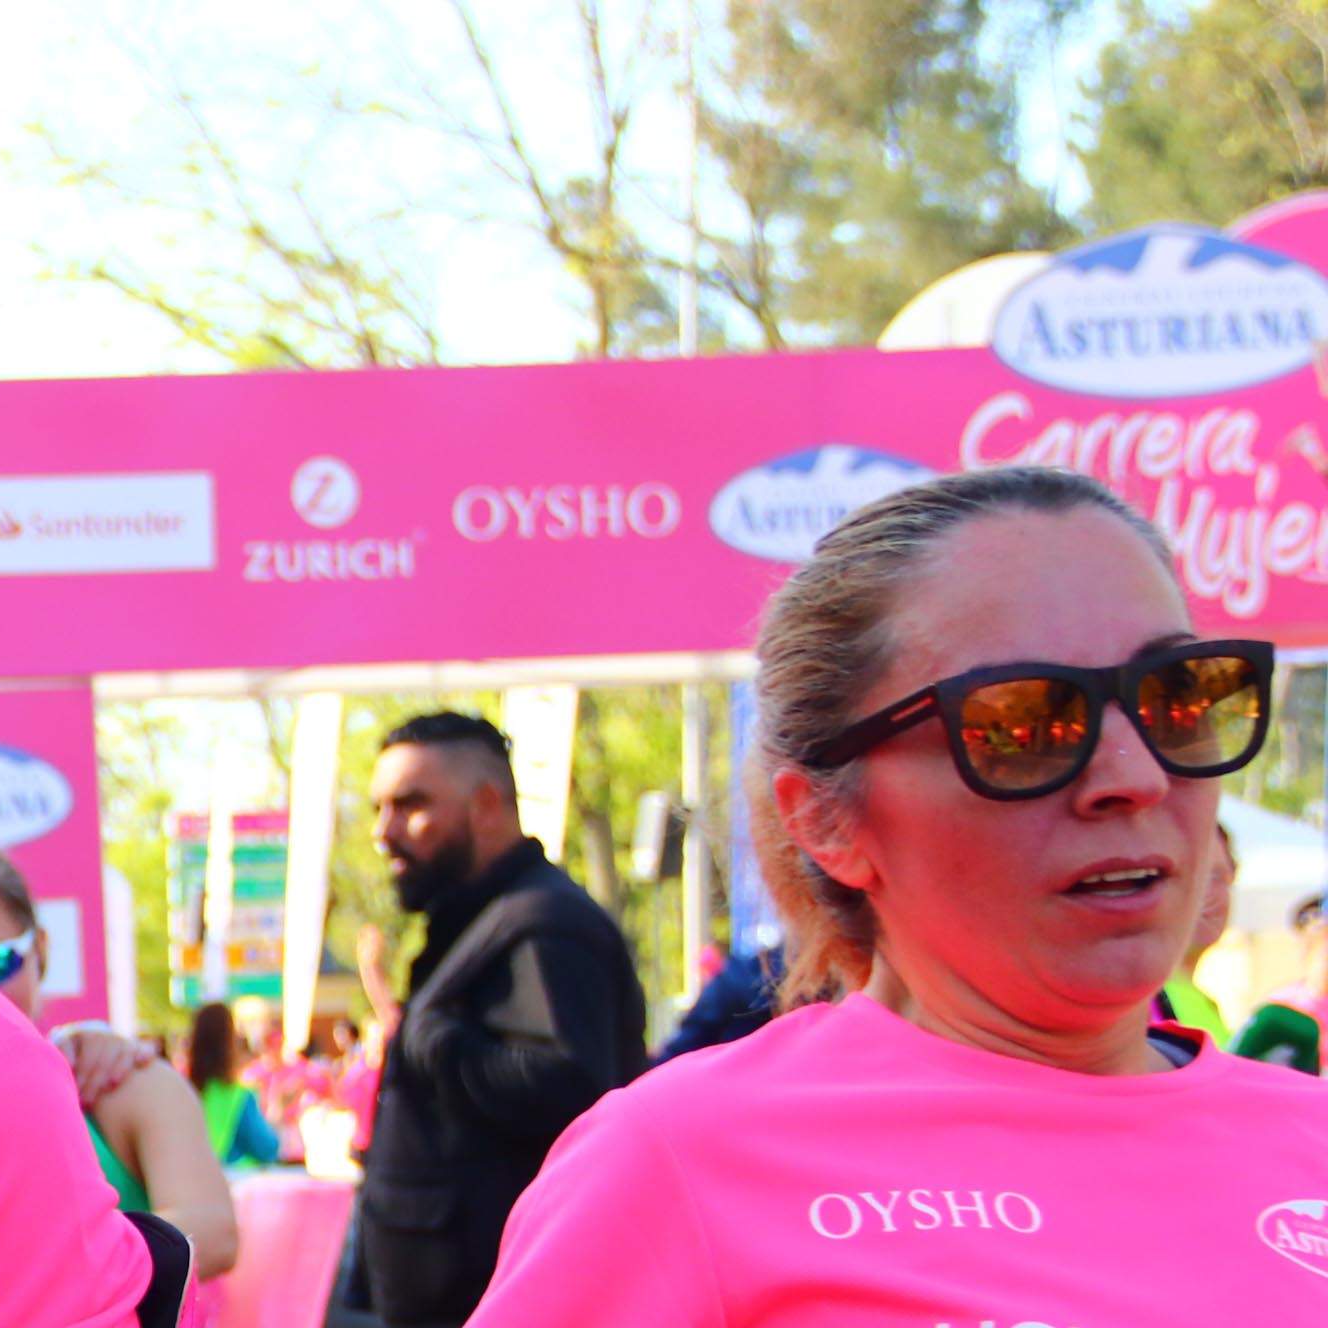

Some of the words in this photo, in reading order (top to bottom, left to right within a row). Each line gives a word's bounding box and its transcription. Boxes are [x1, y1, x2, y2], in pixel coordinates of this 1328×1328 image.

[1014, 300, 1314, 362] ASTURIANA
[959, 391, 1260, 482] Carrera
[27, 508, 184, 540] Santander
[452, 481, 681, 541] OYSHO
[243, 539, 415, 582] ZURICH
[809, 1189, 1042, 1240] OYSHO
